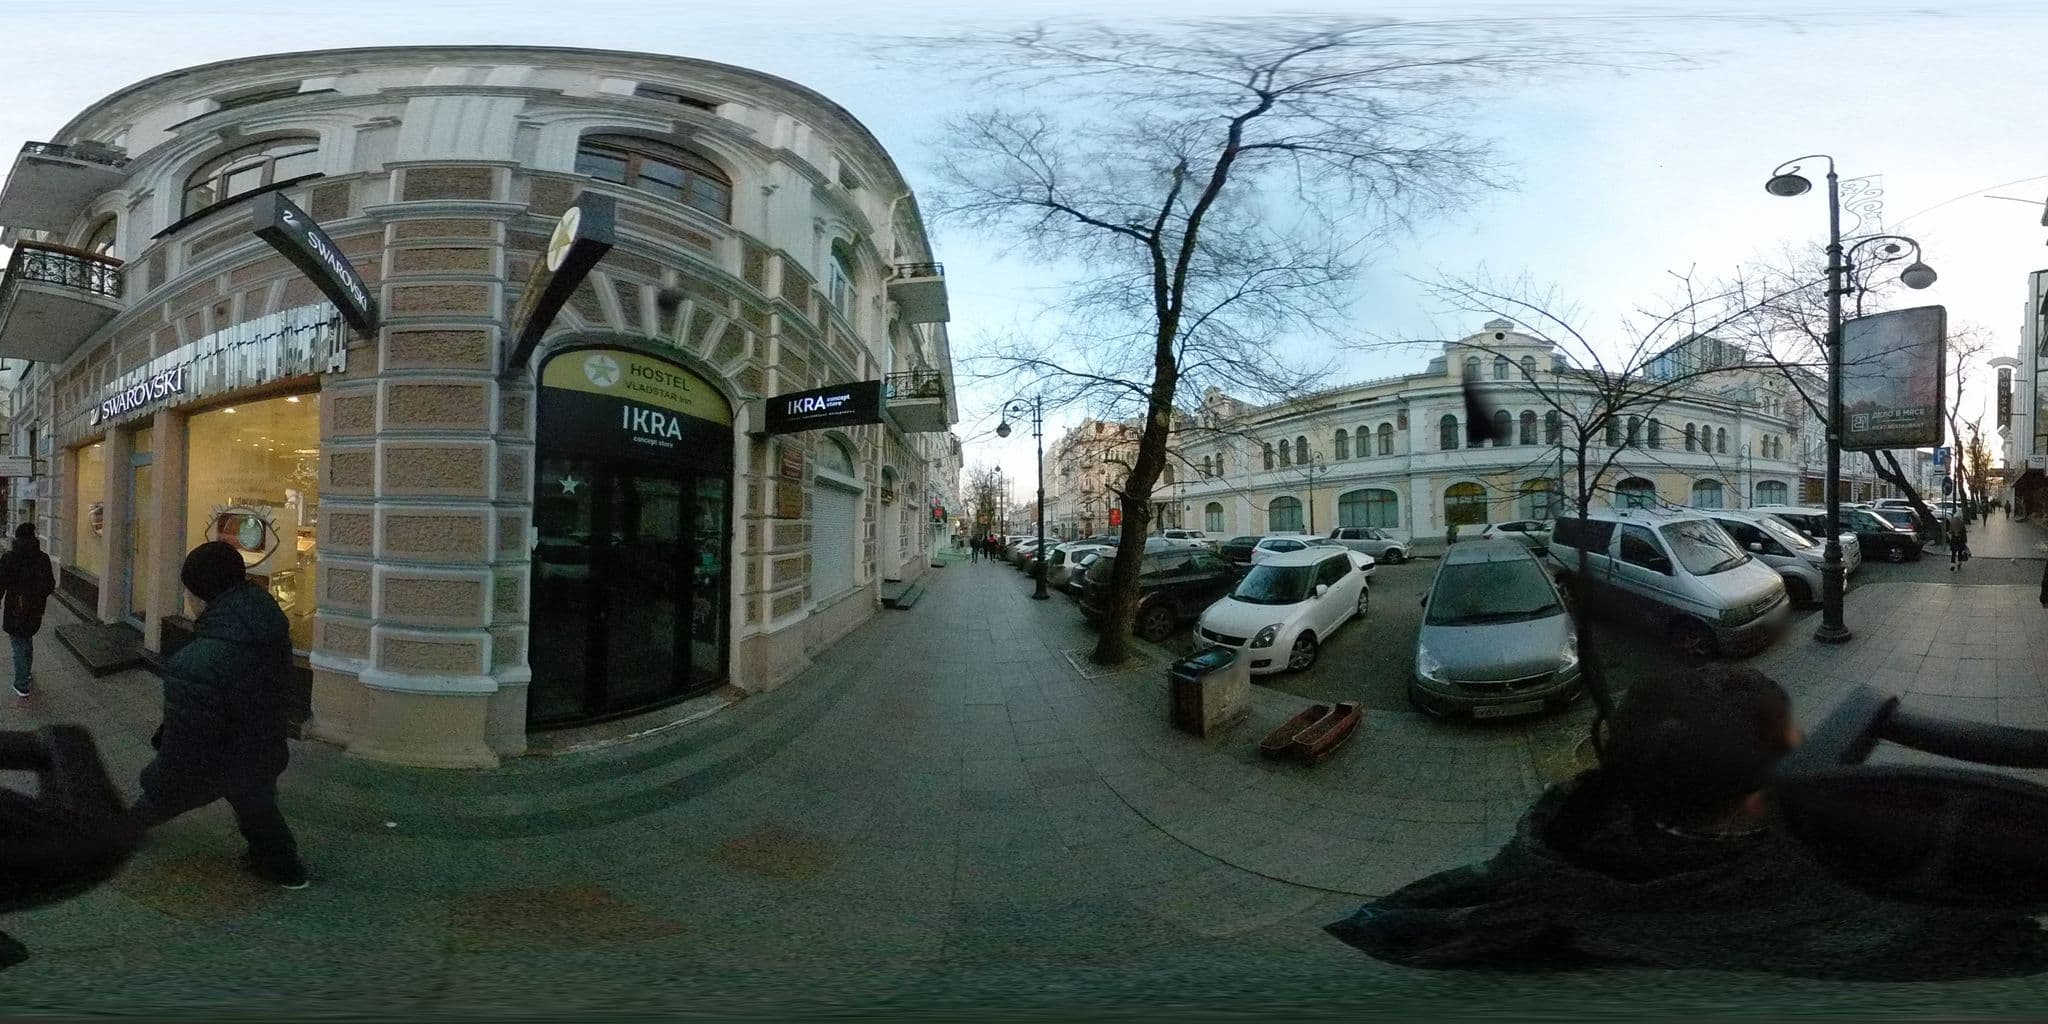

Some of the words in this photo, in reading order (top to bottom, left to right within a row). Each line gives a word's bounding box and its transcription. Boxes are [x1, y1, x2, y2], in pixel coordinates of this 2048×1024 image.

[308, 231, 367, 312] SWAROVSKI
[624, 381, 677, 400] VLADSTAR
[630, 363, 691, 392] HOSTEL
[102, 366, 182, 419] SWAROVSKI
[787, 395, 826, 415] IKRA
[623, 405, 682, 441] IKRA
[633, 436, 658, 446] concept
